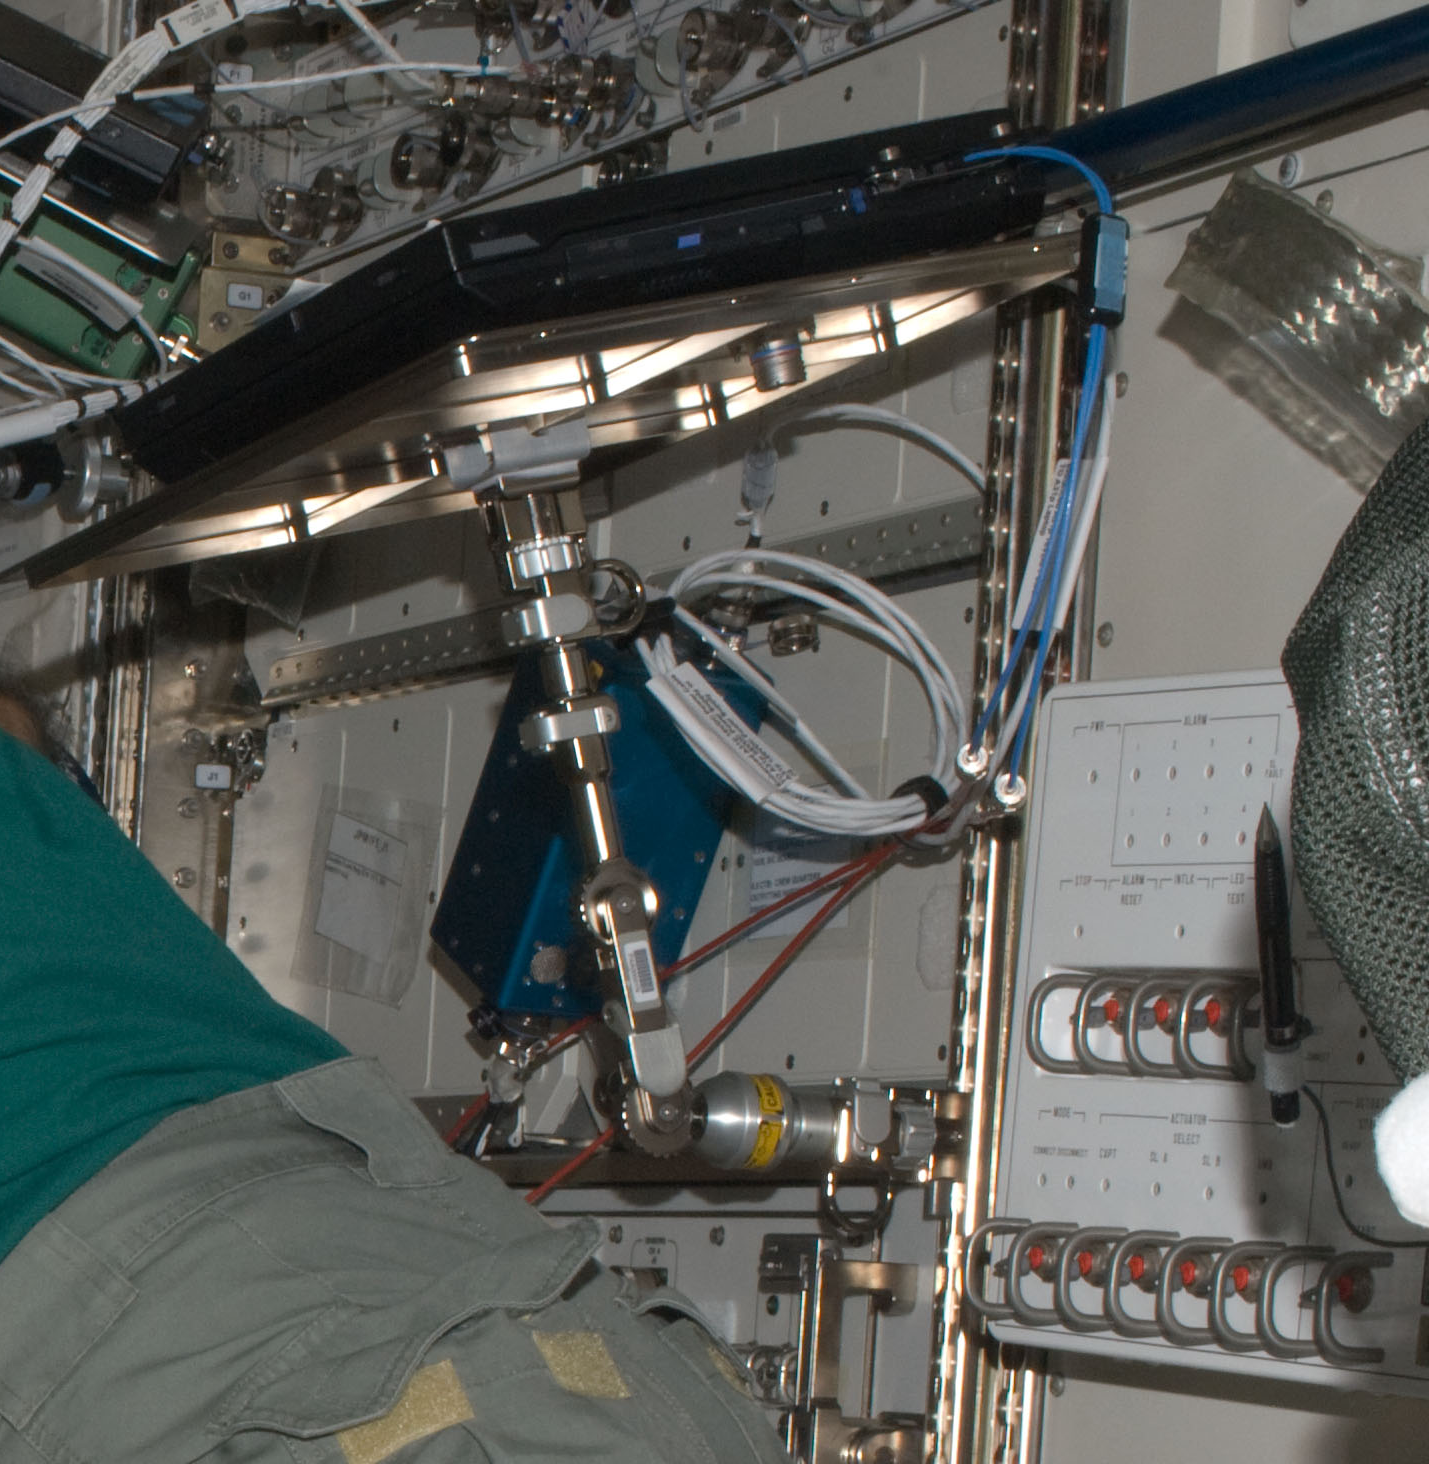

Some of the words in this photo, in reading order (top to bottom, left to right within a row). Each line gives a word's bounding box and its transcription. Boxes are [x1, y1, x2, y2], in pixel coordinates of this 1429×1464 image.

[1184, 715, 1208, 726] ALARM
[1122, 875, 1144, 885] ALARM
[1170, 1113, 1208, 1125] ACTUATOR
